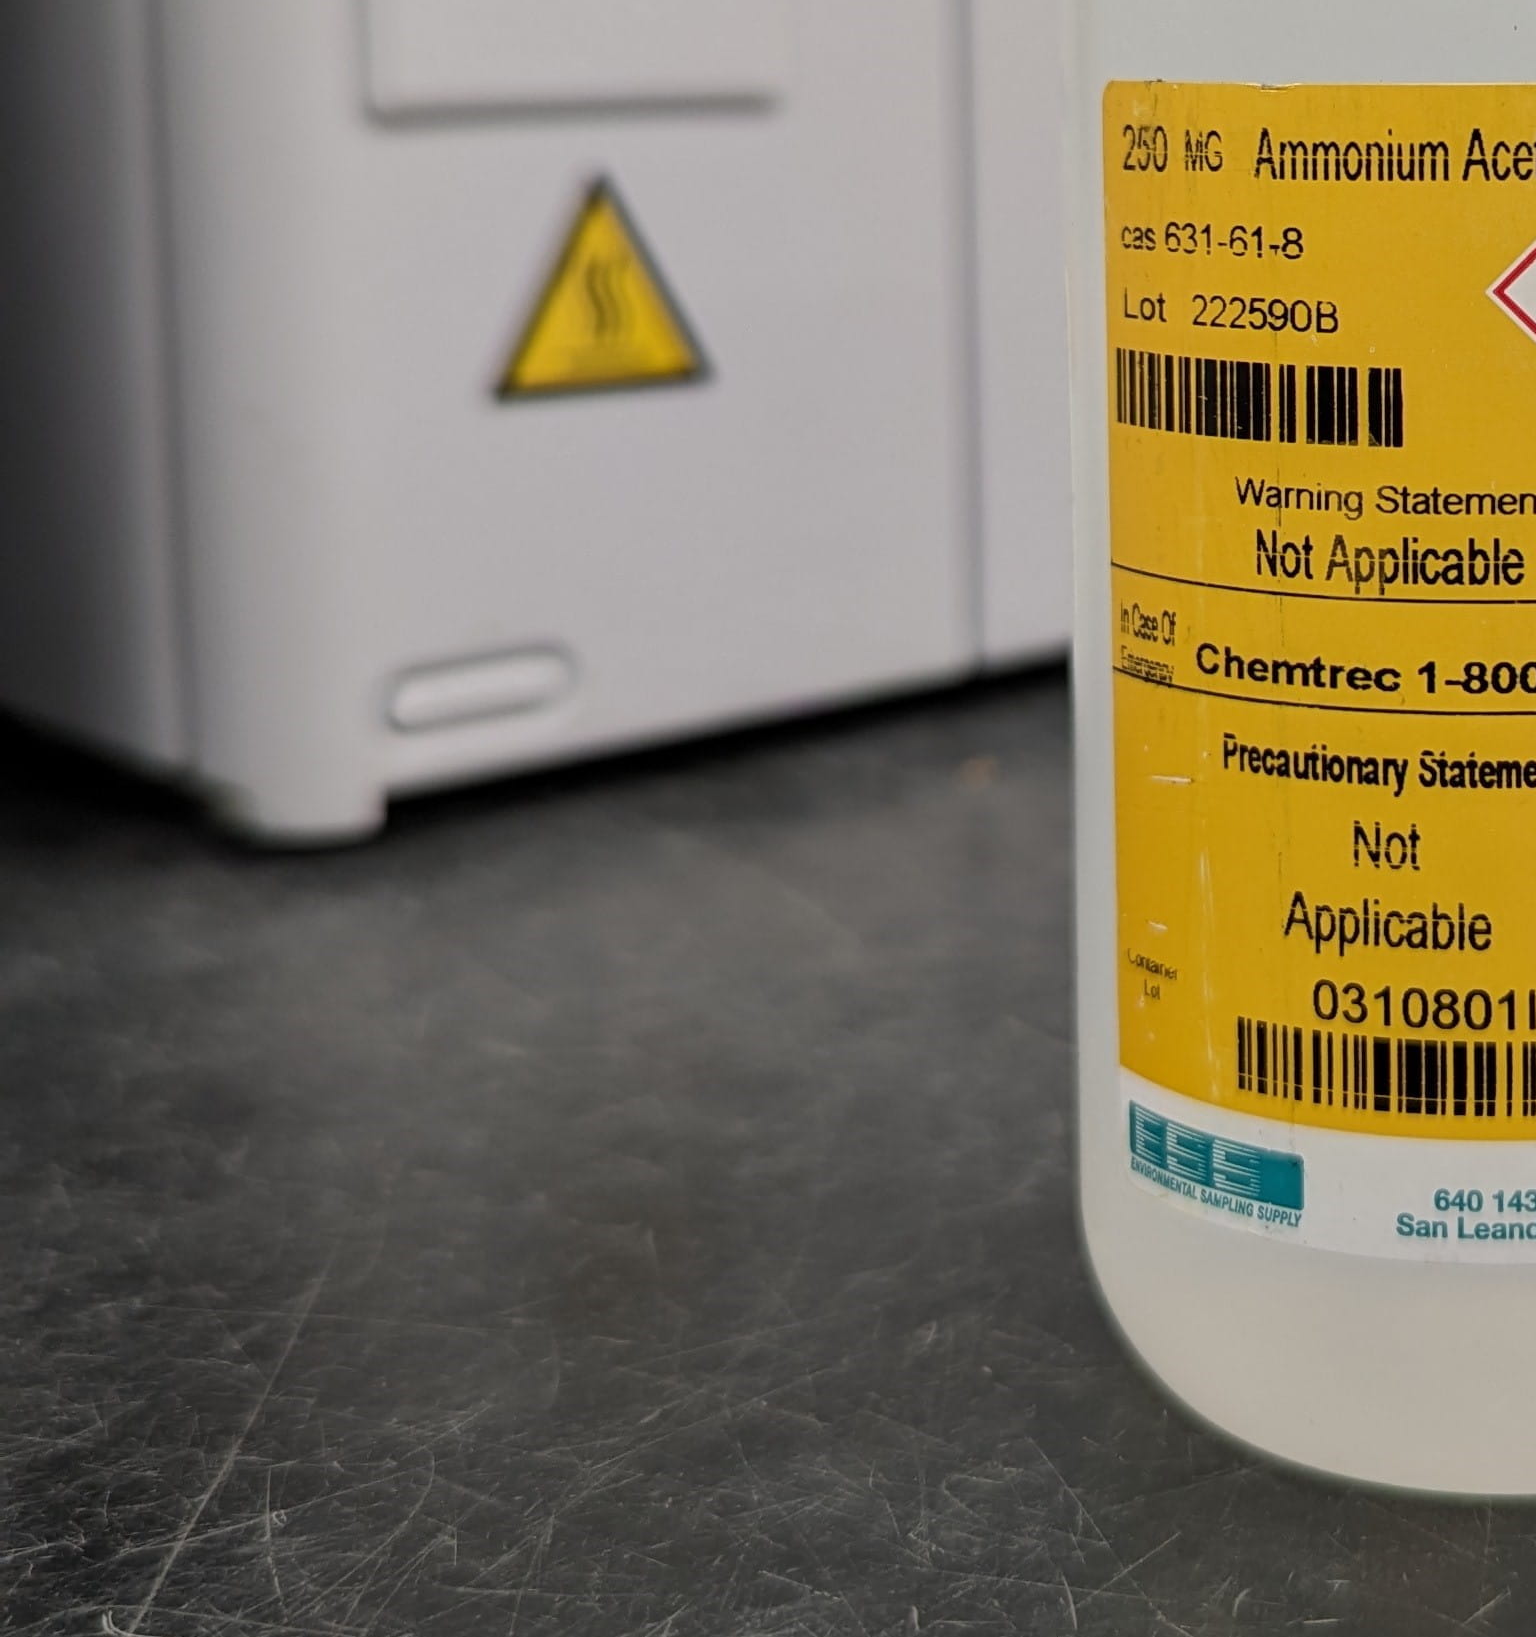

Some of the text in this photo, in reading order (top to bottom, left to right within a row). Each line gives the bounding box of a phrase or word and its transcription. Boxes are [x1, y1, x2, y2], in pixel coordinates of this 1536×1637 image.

[1122, 124, 1169, 172] 250
[1184, 129, 1224, 172] MG
[1253, 127, 1450, 181] Ammonium
[1120, 221, 1305, 260] cas 631-61-8
[1123, 288, 1340, 334] Lot 222590B
[1234, 475, 1364, 521] Warning
[1255, 528, 1526, 596] Not Applicable
[1195, 642, 1402, 693] Chemtrec
[1222, 731, 1409, 798] Precautionary
[1353, 819, 1421, 872] Not
[1283, 890, 1493, 957] Applicable
[1130, 1155, 1303, 1229] ENVIRONMENTAL SAMPLING SUPPLY
[1432, 1187, 1484, 1213] 640
[1395, 1212, 1449, 1240] San
